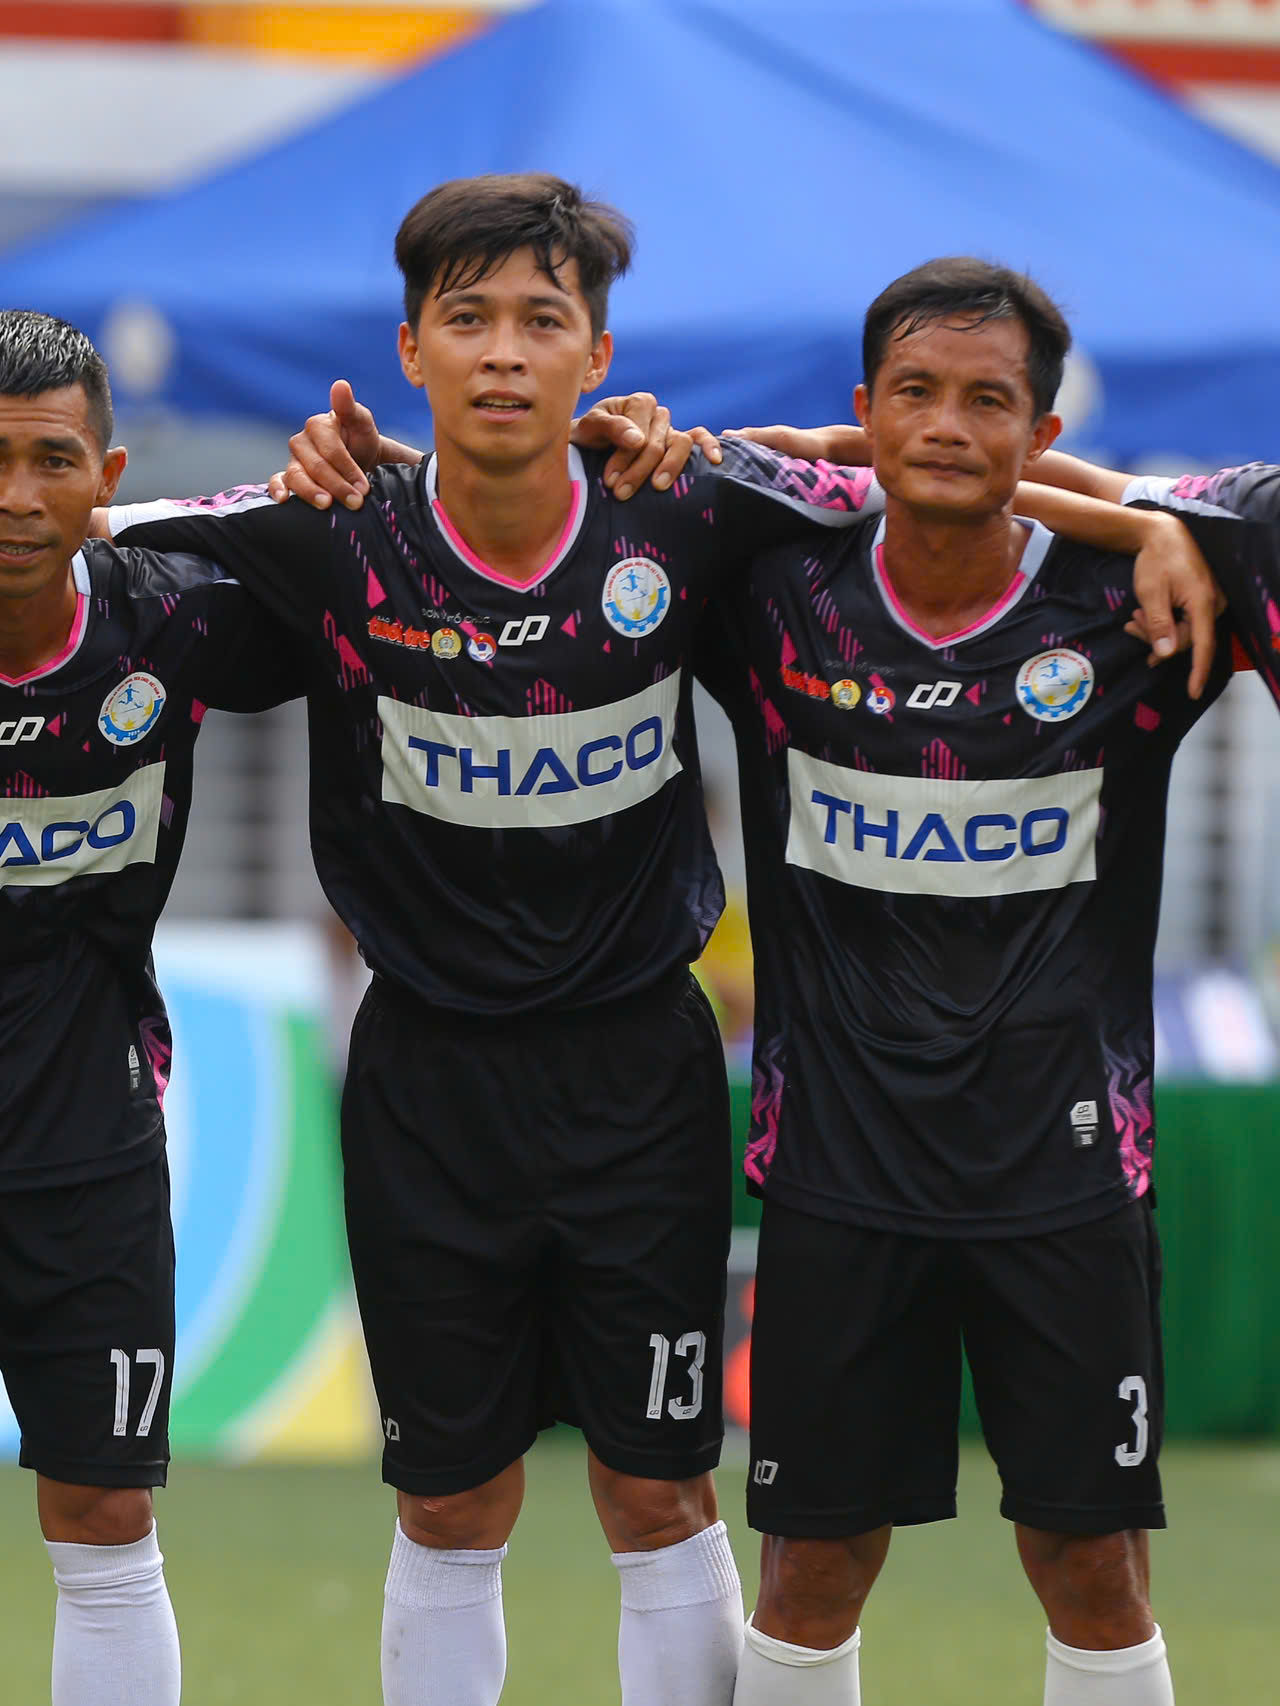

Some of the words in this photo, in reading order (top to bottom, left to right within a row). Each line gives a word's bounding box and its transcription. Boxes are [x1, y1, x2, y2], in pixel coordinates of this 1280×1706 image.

[409, 716, 663, 796] THACO
[811, 790, 1070, 862] THACO
[110, 1348, 165, 1437] 17
[646, 1331, 706, 1420] 13
[1114, 1375, 1148, 1467] 3
